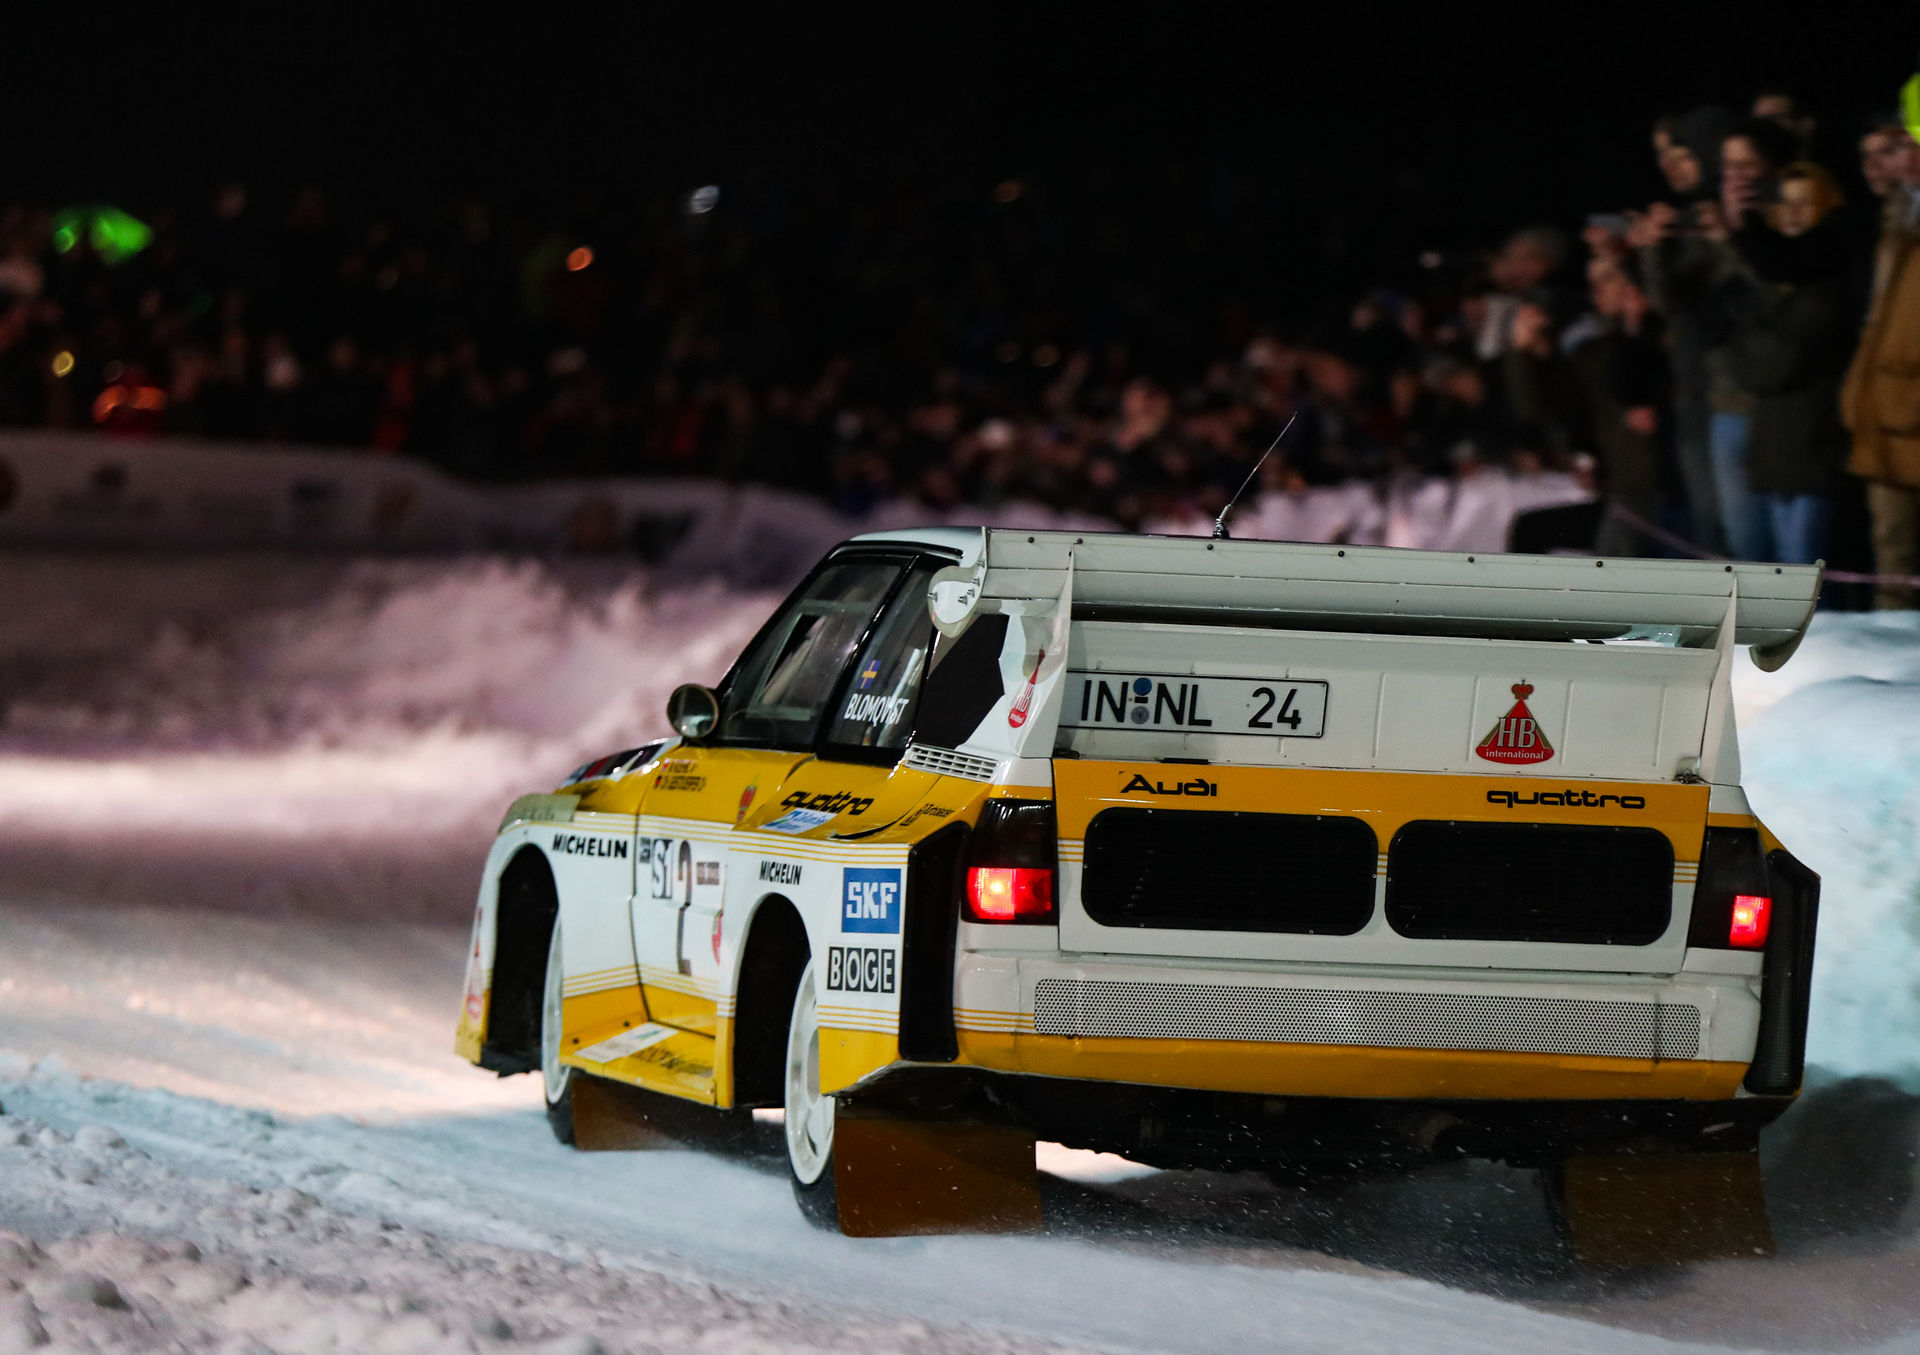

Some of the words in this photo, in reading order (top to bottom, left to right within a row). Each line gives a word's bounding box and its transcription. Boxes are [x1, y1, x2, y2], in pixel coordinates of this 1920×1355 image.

[1247, 687, 1302, 730] 24
[1496, 716, 1537, 748] HB
[1485, 748, 1545, 760] international
[1120, 774, 1218, 796] Audi
[780, 791, 875, 816] quattro
[1487, 789, 1645, 809] quattro
[552, 834, 628, 859] MICHELIN
[652, 839, 673, 898] S1
[759, 861, 802, 885] MICHELIN
[846, 881, 897, 920] SKF
[828, 948, 894, 991] BOGE
